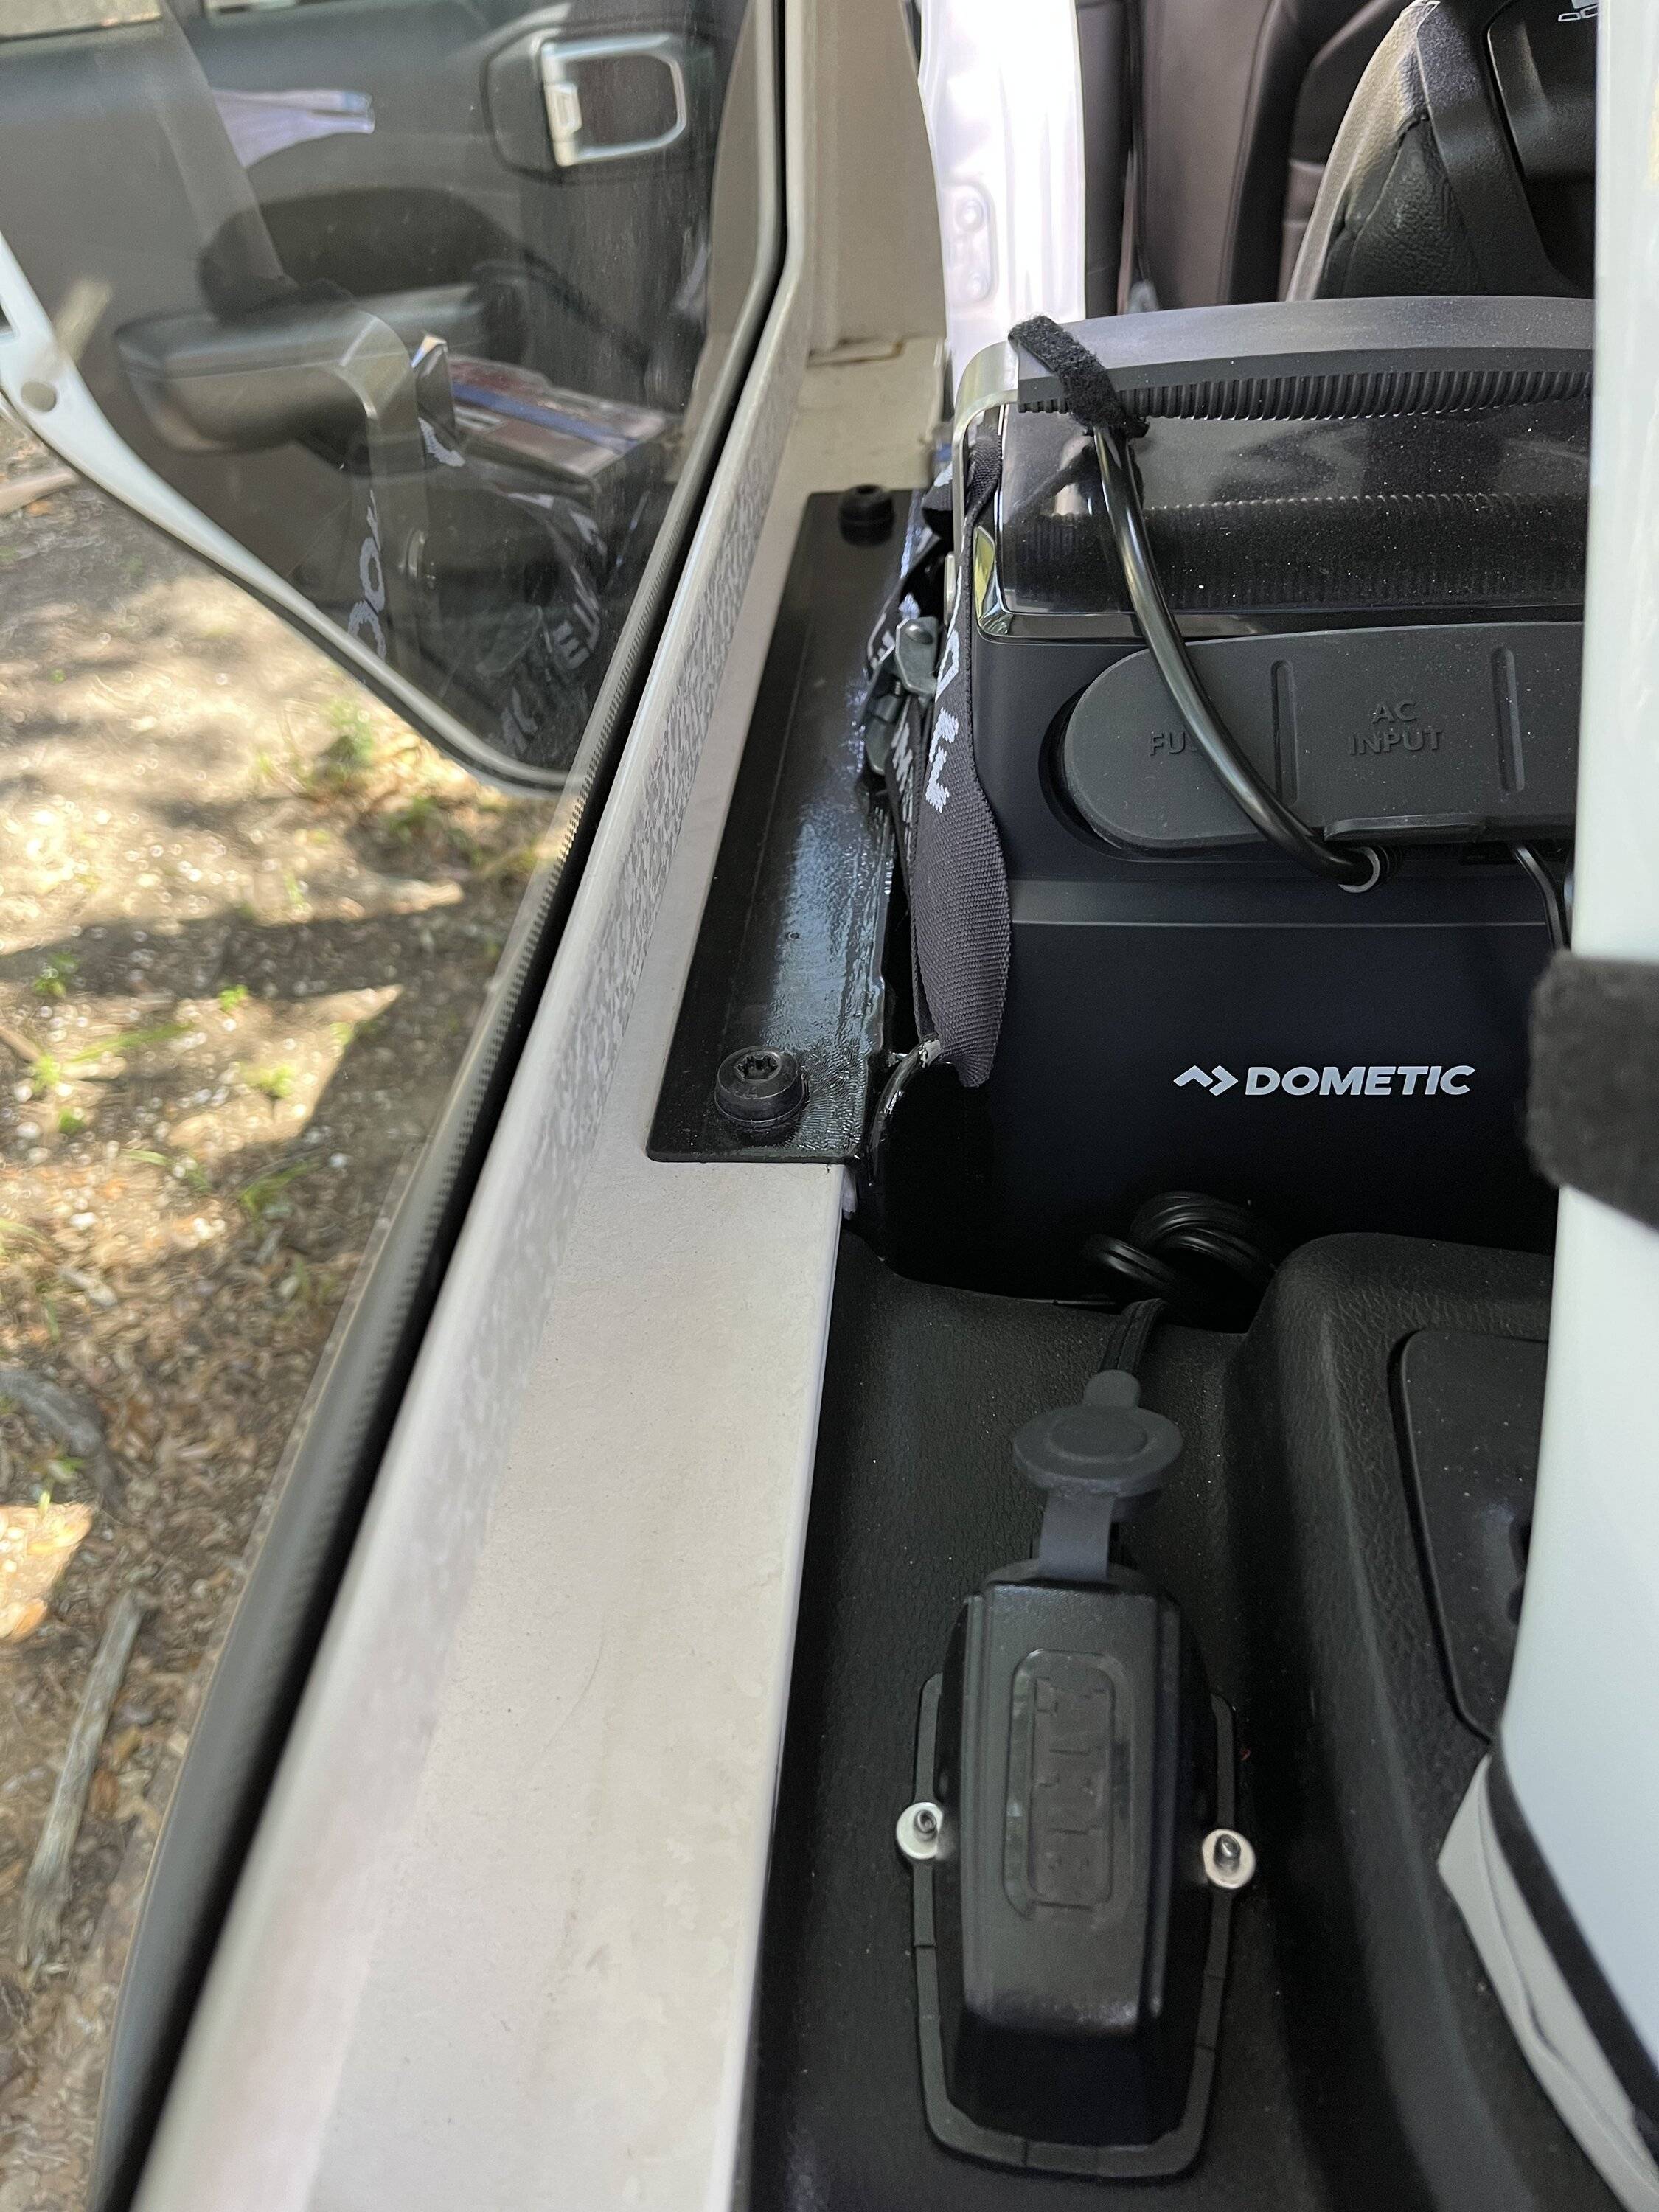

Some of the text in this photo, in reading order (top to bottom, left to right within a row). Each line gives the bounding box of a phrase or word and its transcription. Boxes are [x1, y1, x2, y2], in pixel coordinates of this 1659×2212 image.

[1371, 701, 1420, 724] AC
[1149, 731, 1200, 757] FU
[1349, 729, 1444, 757] INPUT
[1245, 1065, 1475, 1096] DOMETIC
